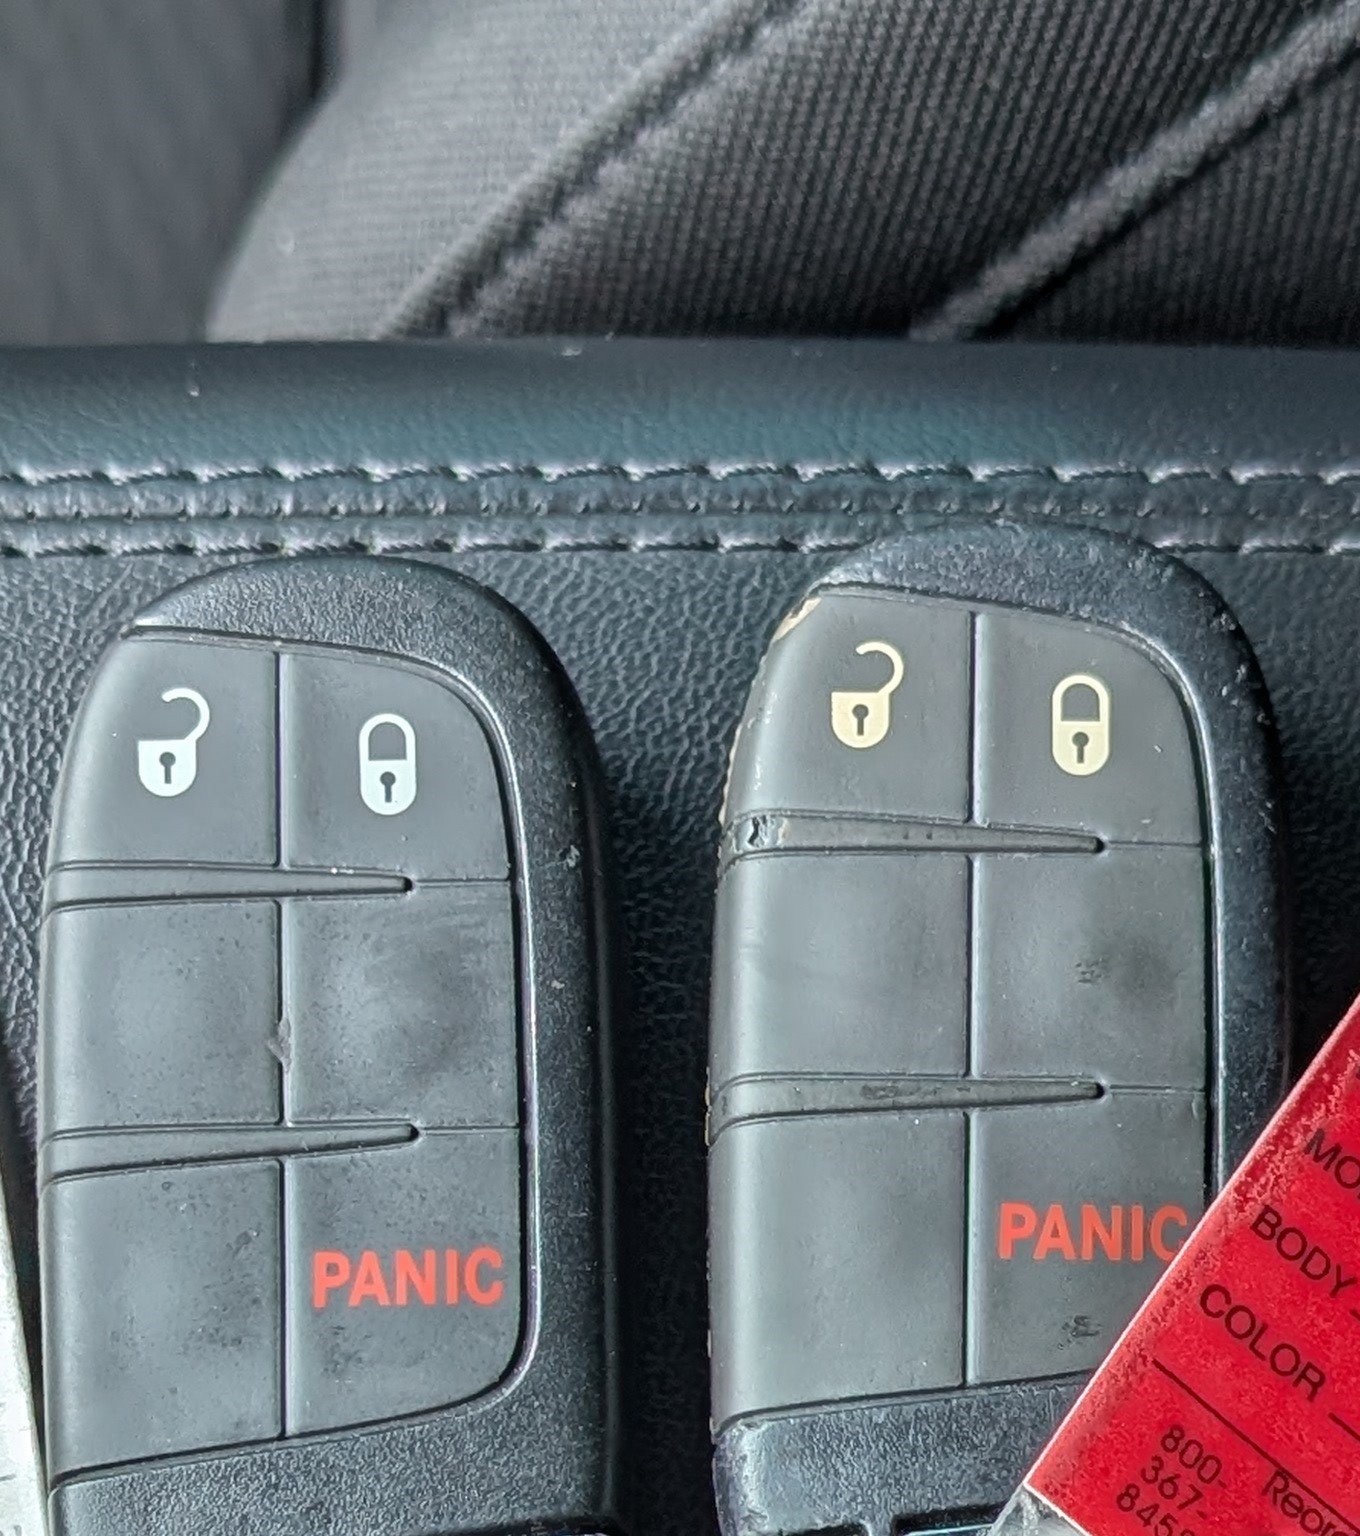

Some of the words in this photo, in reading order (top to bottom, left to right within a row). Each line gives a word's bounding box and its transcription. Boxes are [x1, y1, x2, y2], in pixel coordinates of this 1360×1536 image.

[997, 1202, 1188, 1261] PANIC
[1249, 1203, 1357, 1299] BODY
[310, 1245, 504, 1309] PANIC
[1200, 1283, 1326, 1402] COLOR
[1140, 1455, 1207, 1520] 367-
[1161, 1424, 1228, 1491] 800-
